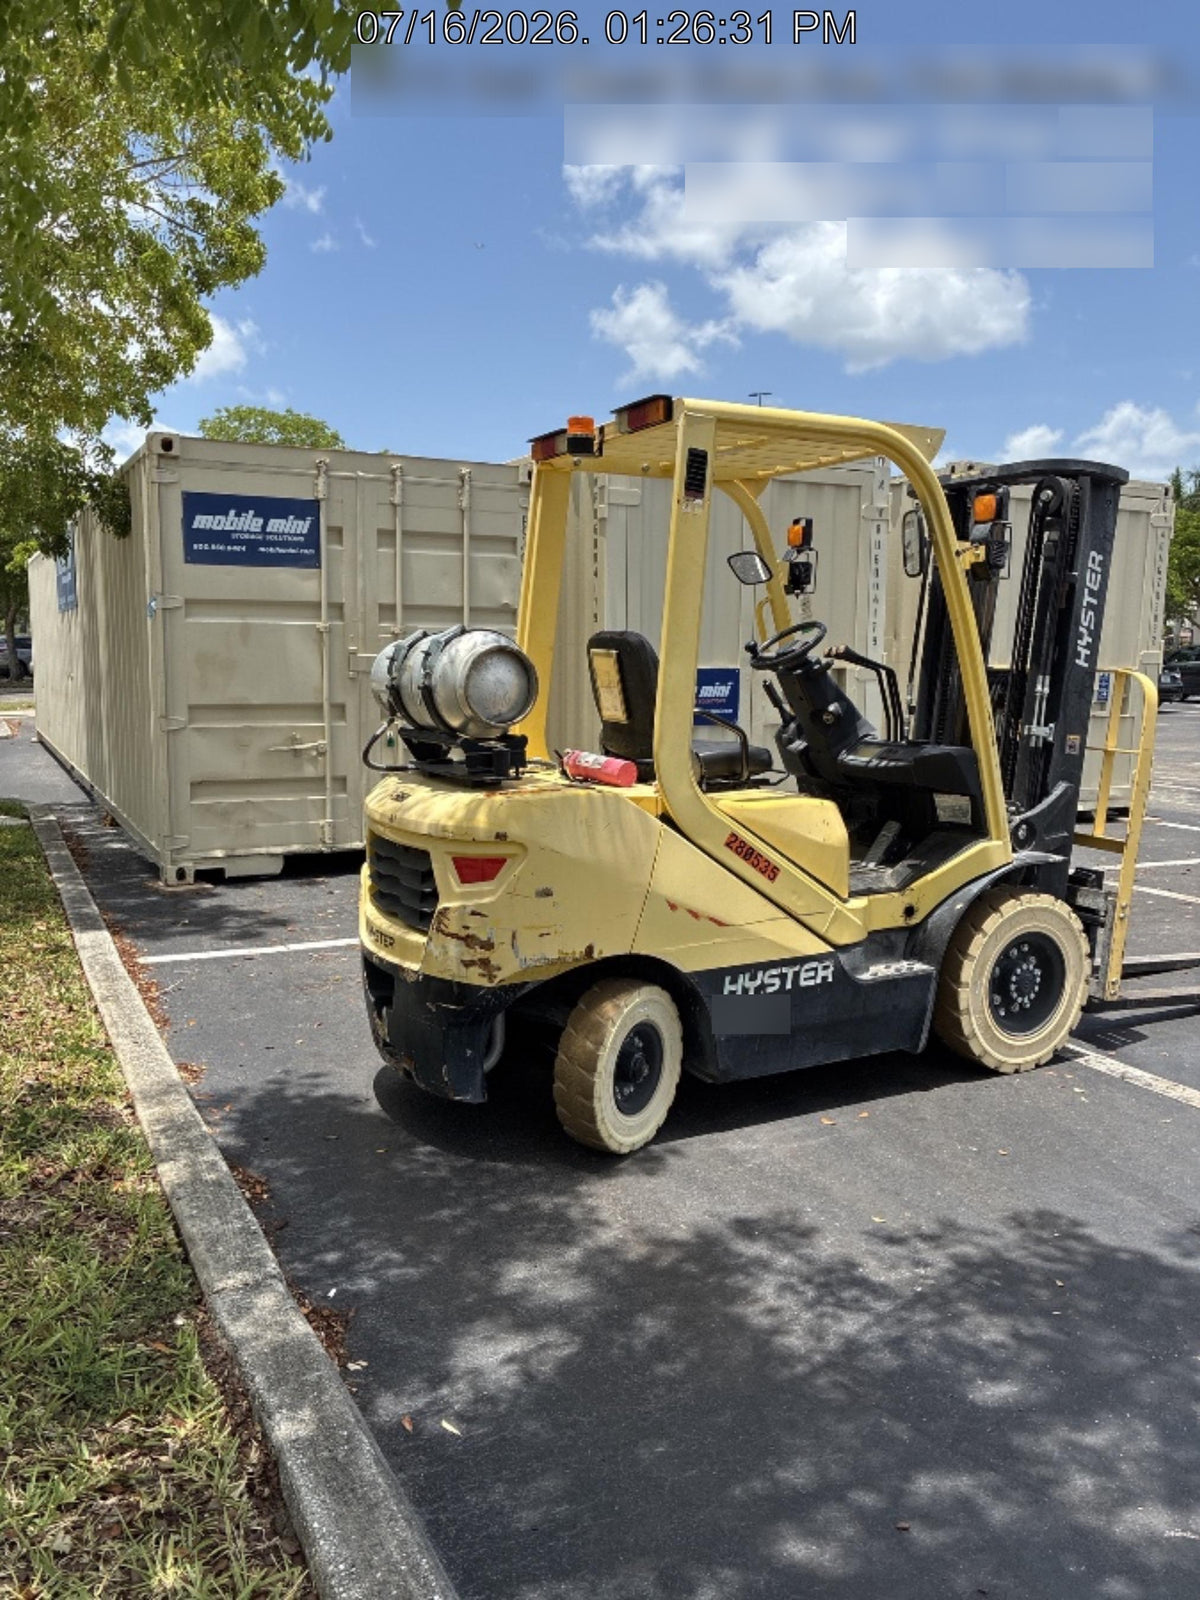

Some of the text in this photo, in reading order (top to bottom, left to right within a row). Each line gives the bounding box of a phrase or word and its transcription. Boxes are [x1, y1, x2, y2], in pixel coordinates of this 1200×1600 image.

[191, 509, 315, 534] mobile mini
[1075, 550, 1104, 668] HYSTER
[698, 681, 734, 698] mini
[723, 959, 834, 996] HYSTER
